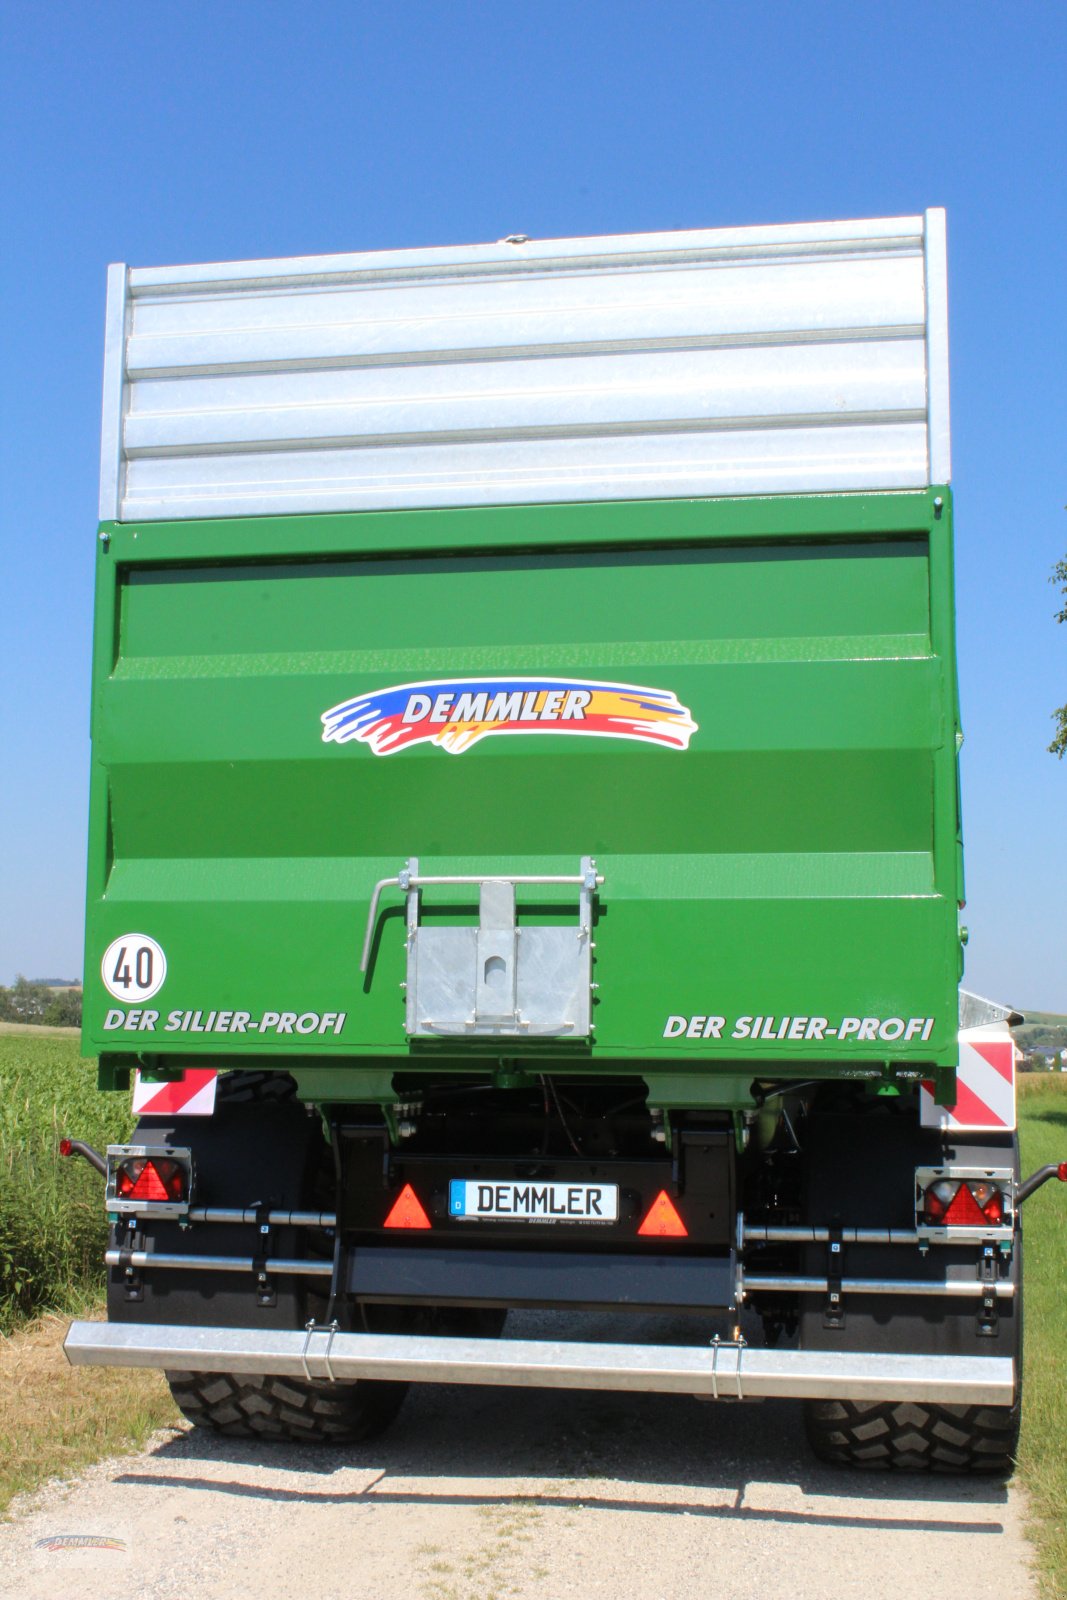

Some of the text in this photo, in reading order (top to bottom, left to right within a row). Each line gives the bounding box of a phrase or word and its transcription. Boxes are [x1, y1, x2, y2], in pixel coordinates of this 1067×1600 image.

[401, 690, 593, 724] DEMMLER
[112, 946, 154, 989] 40
[103, 1009, 348, 1035] DER SILIER-PROFI
[662, 1015, 936, 1041] DER SILIER-PROFI
[455, 1201, 462, 1210] D
[477, 1185, 602, 1215] DEMMLER
